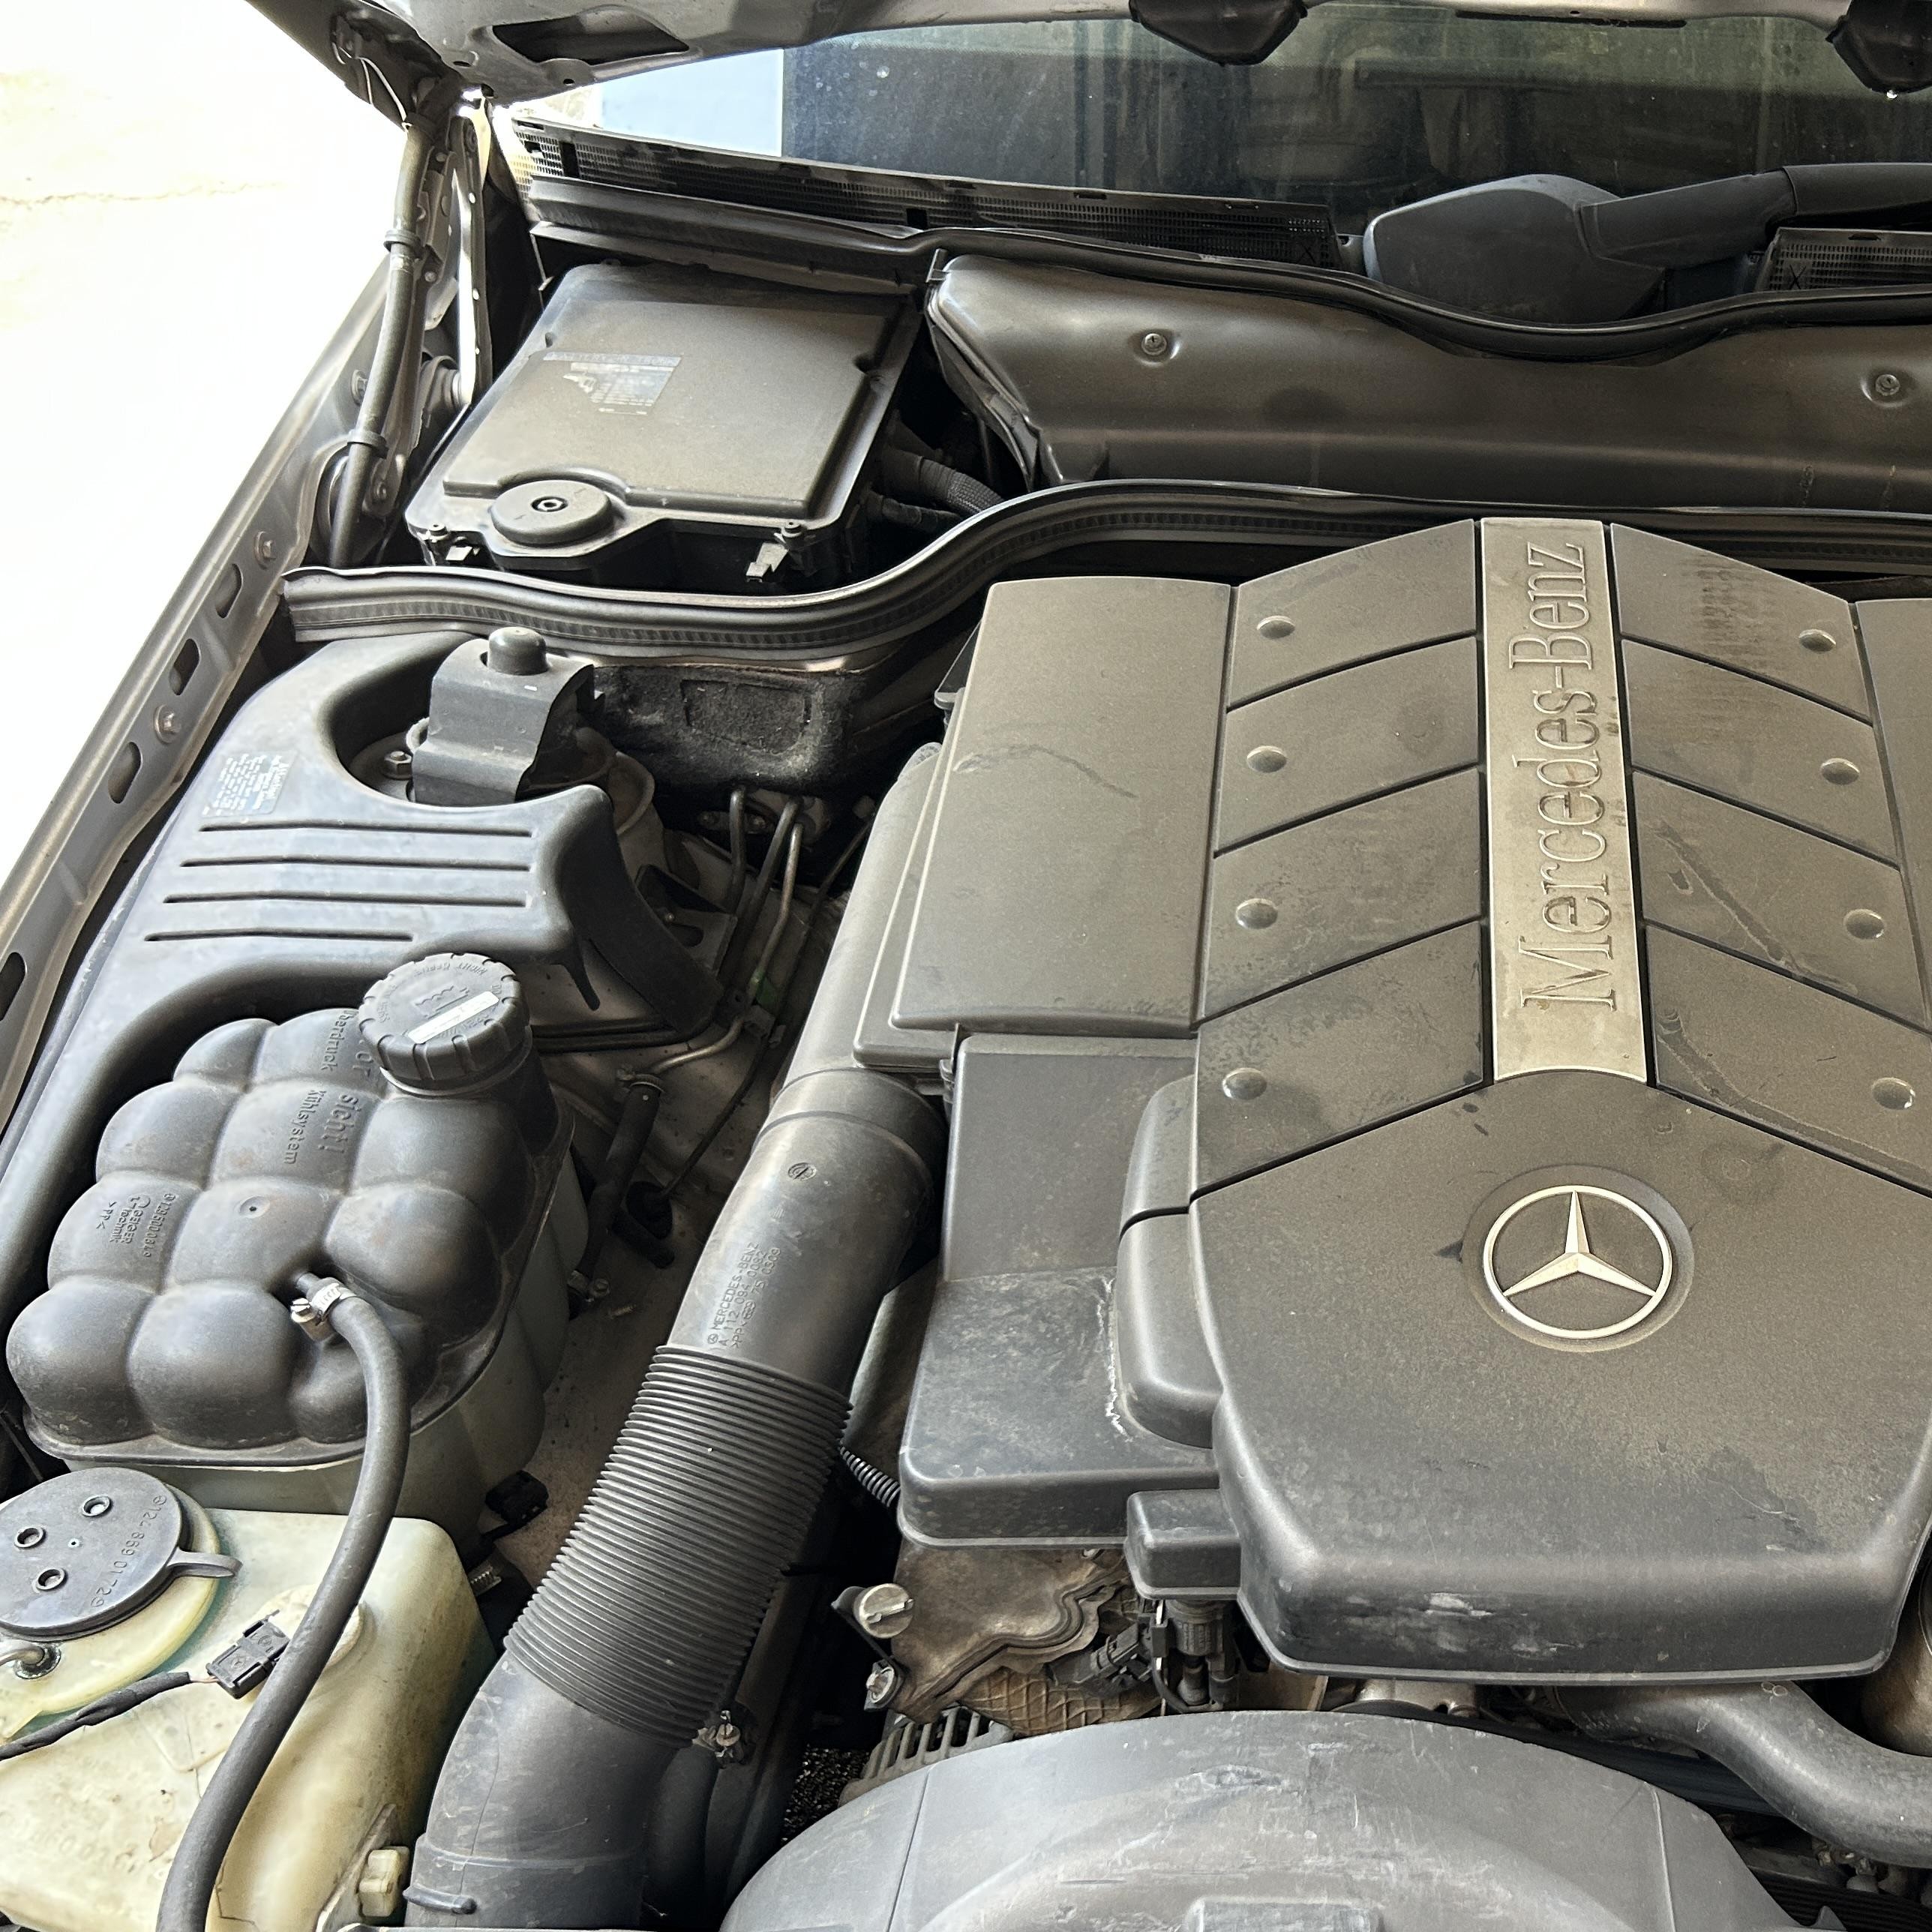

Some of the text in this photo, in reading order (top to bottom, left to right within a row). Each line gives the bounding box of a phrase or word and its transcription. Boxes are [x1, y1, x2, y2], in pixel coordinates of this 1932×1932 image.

[1508, 542, 1617, 1011] Mercedes-Benz
[284, 1090, 326, 1165] Kühlsystem
[318, 1040, 374, 1154] or sicht!
[712, 1242, 759, 1330] MERCEDES-BENZ
[718, 1339, 729, 1347] A
[724, 1310, 740, 1330] 112
[121, 1532, 145, 1556] 869
